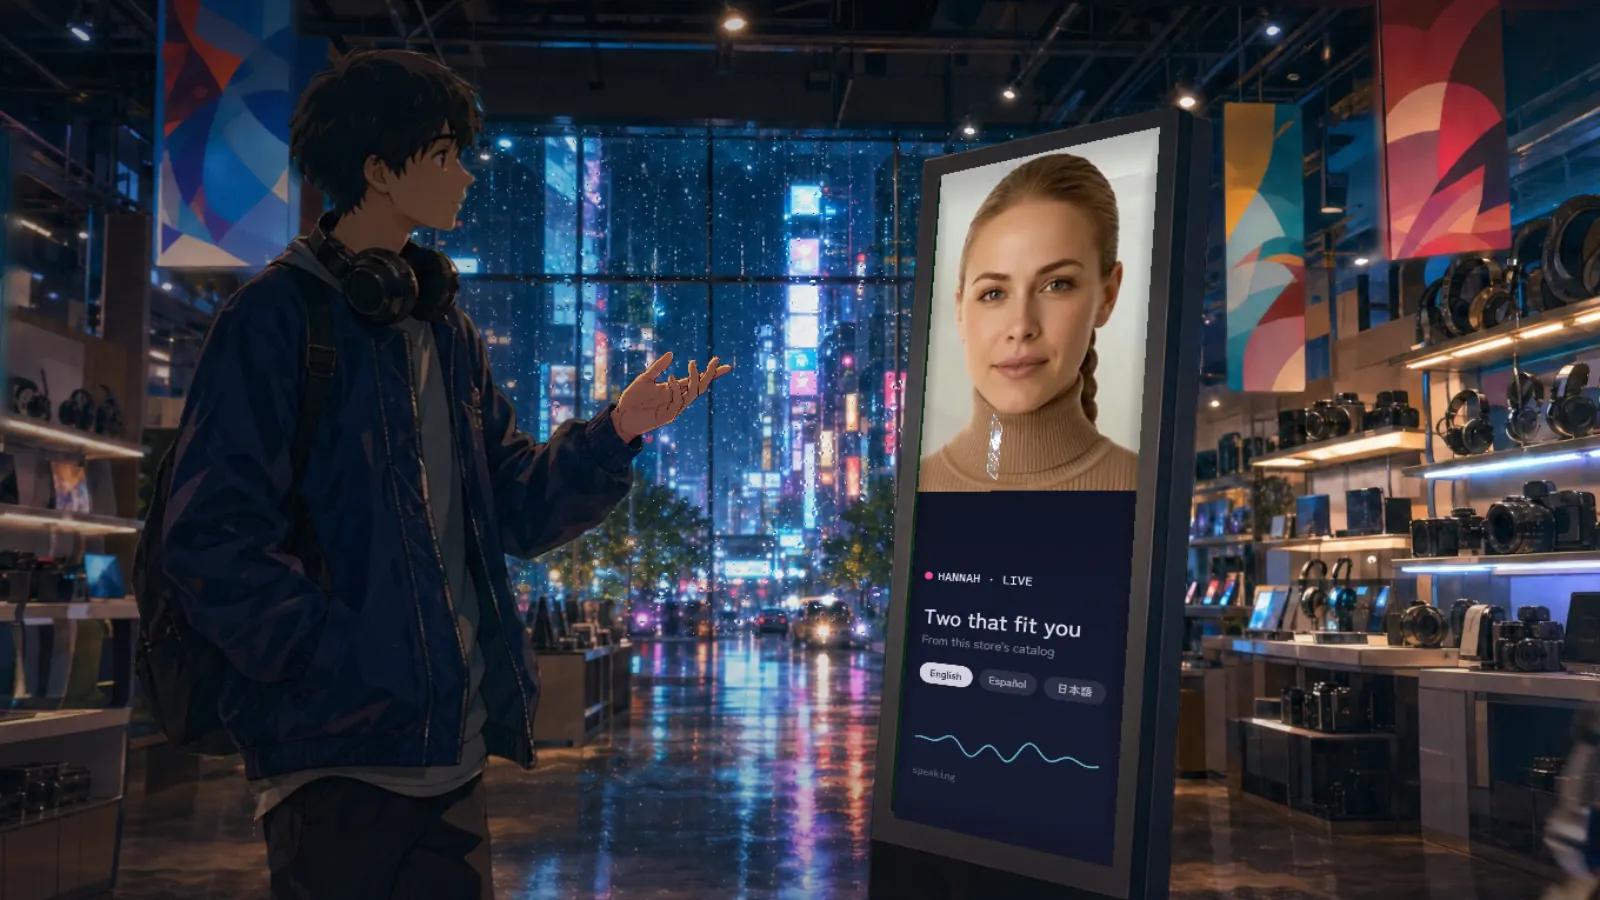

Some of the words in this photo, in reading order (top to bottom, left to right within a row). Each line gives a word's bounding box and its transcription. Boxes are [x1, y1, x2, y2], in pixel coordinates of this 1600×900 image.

[938, 572, 981, 584] HANNAH
[1002, 575, 1033, 587] LIVE
[924, 608, 962, 627] Two
[967, 612, 1008, 632] that
[1013, 615, 1038, 635] fit
[1043, 622, 1081, 640] you
[921, 634, 948, 646] From
[951, 637, 970, 648] this
[1012, 645, 1055, 660] catalog
[929, 668, 962, 682] English
[988, 676, 1027, 690] Español
[1058, 683, 1093, 698] 日本語
[912, 767, 956, 783] speaking
